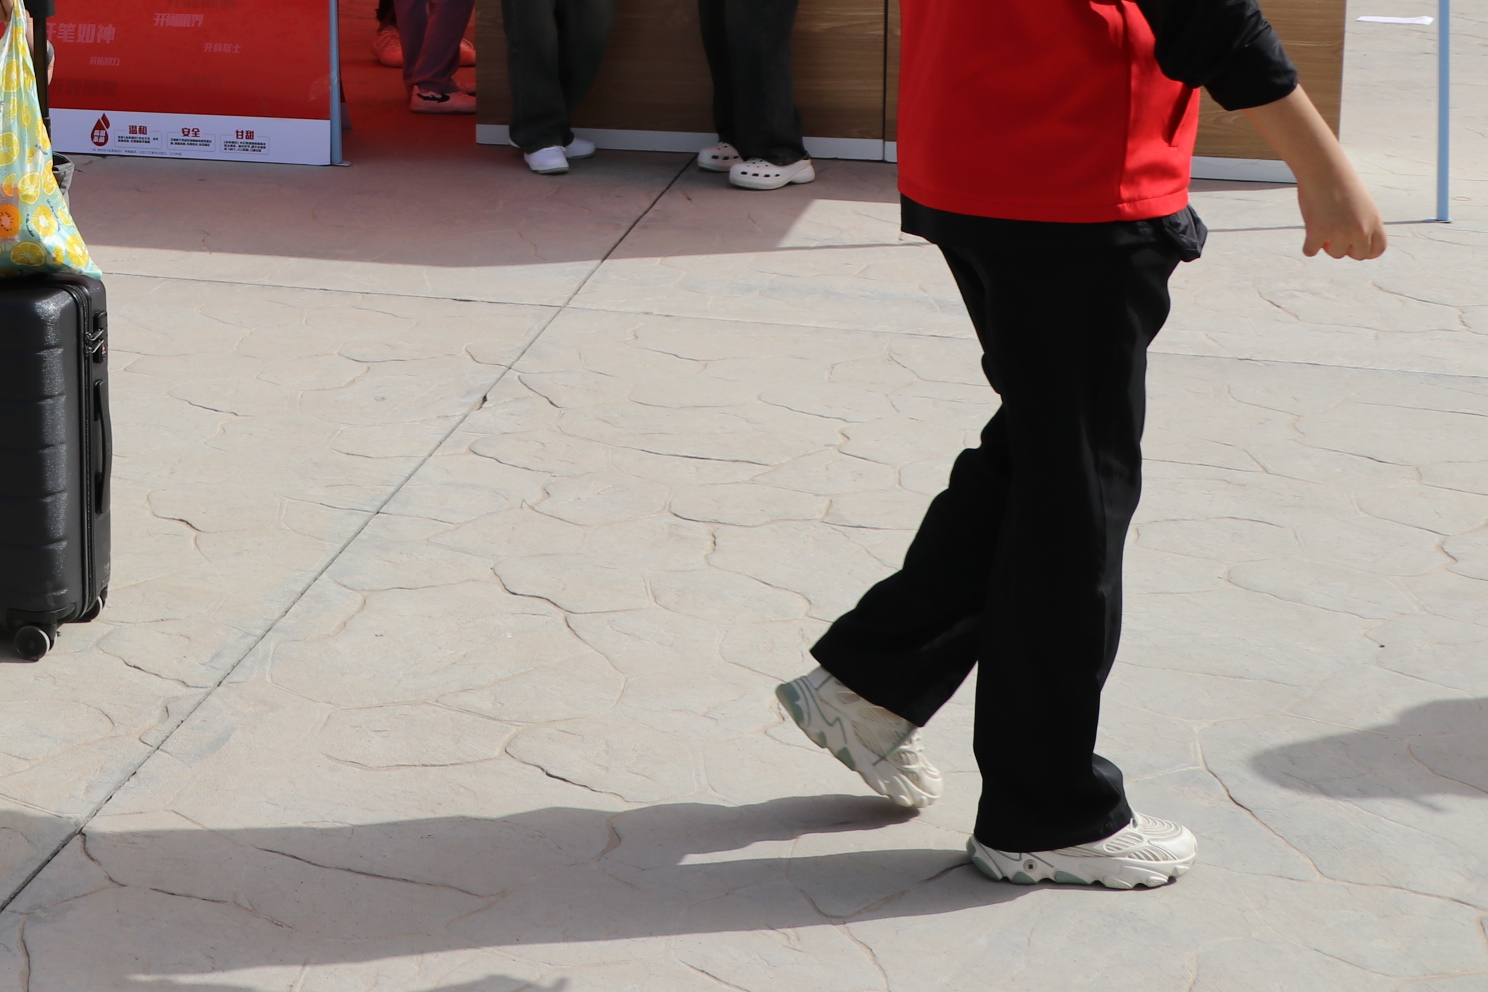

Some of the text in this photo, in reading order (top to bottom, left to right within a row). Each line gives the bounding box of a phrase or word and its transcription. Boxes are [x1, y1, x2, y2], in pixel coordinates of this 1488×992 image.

[128, 124, 148, 135] 温和
[181, 127, 201, 138] 安全
[235, 129, 255, 140] 甘甜
